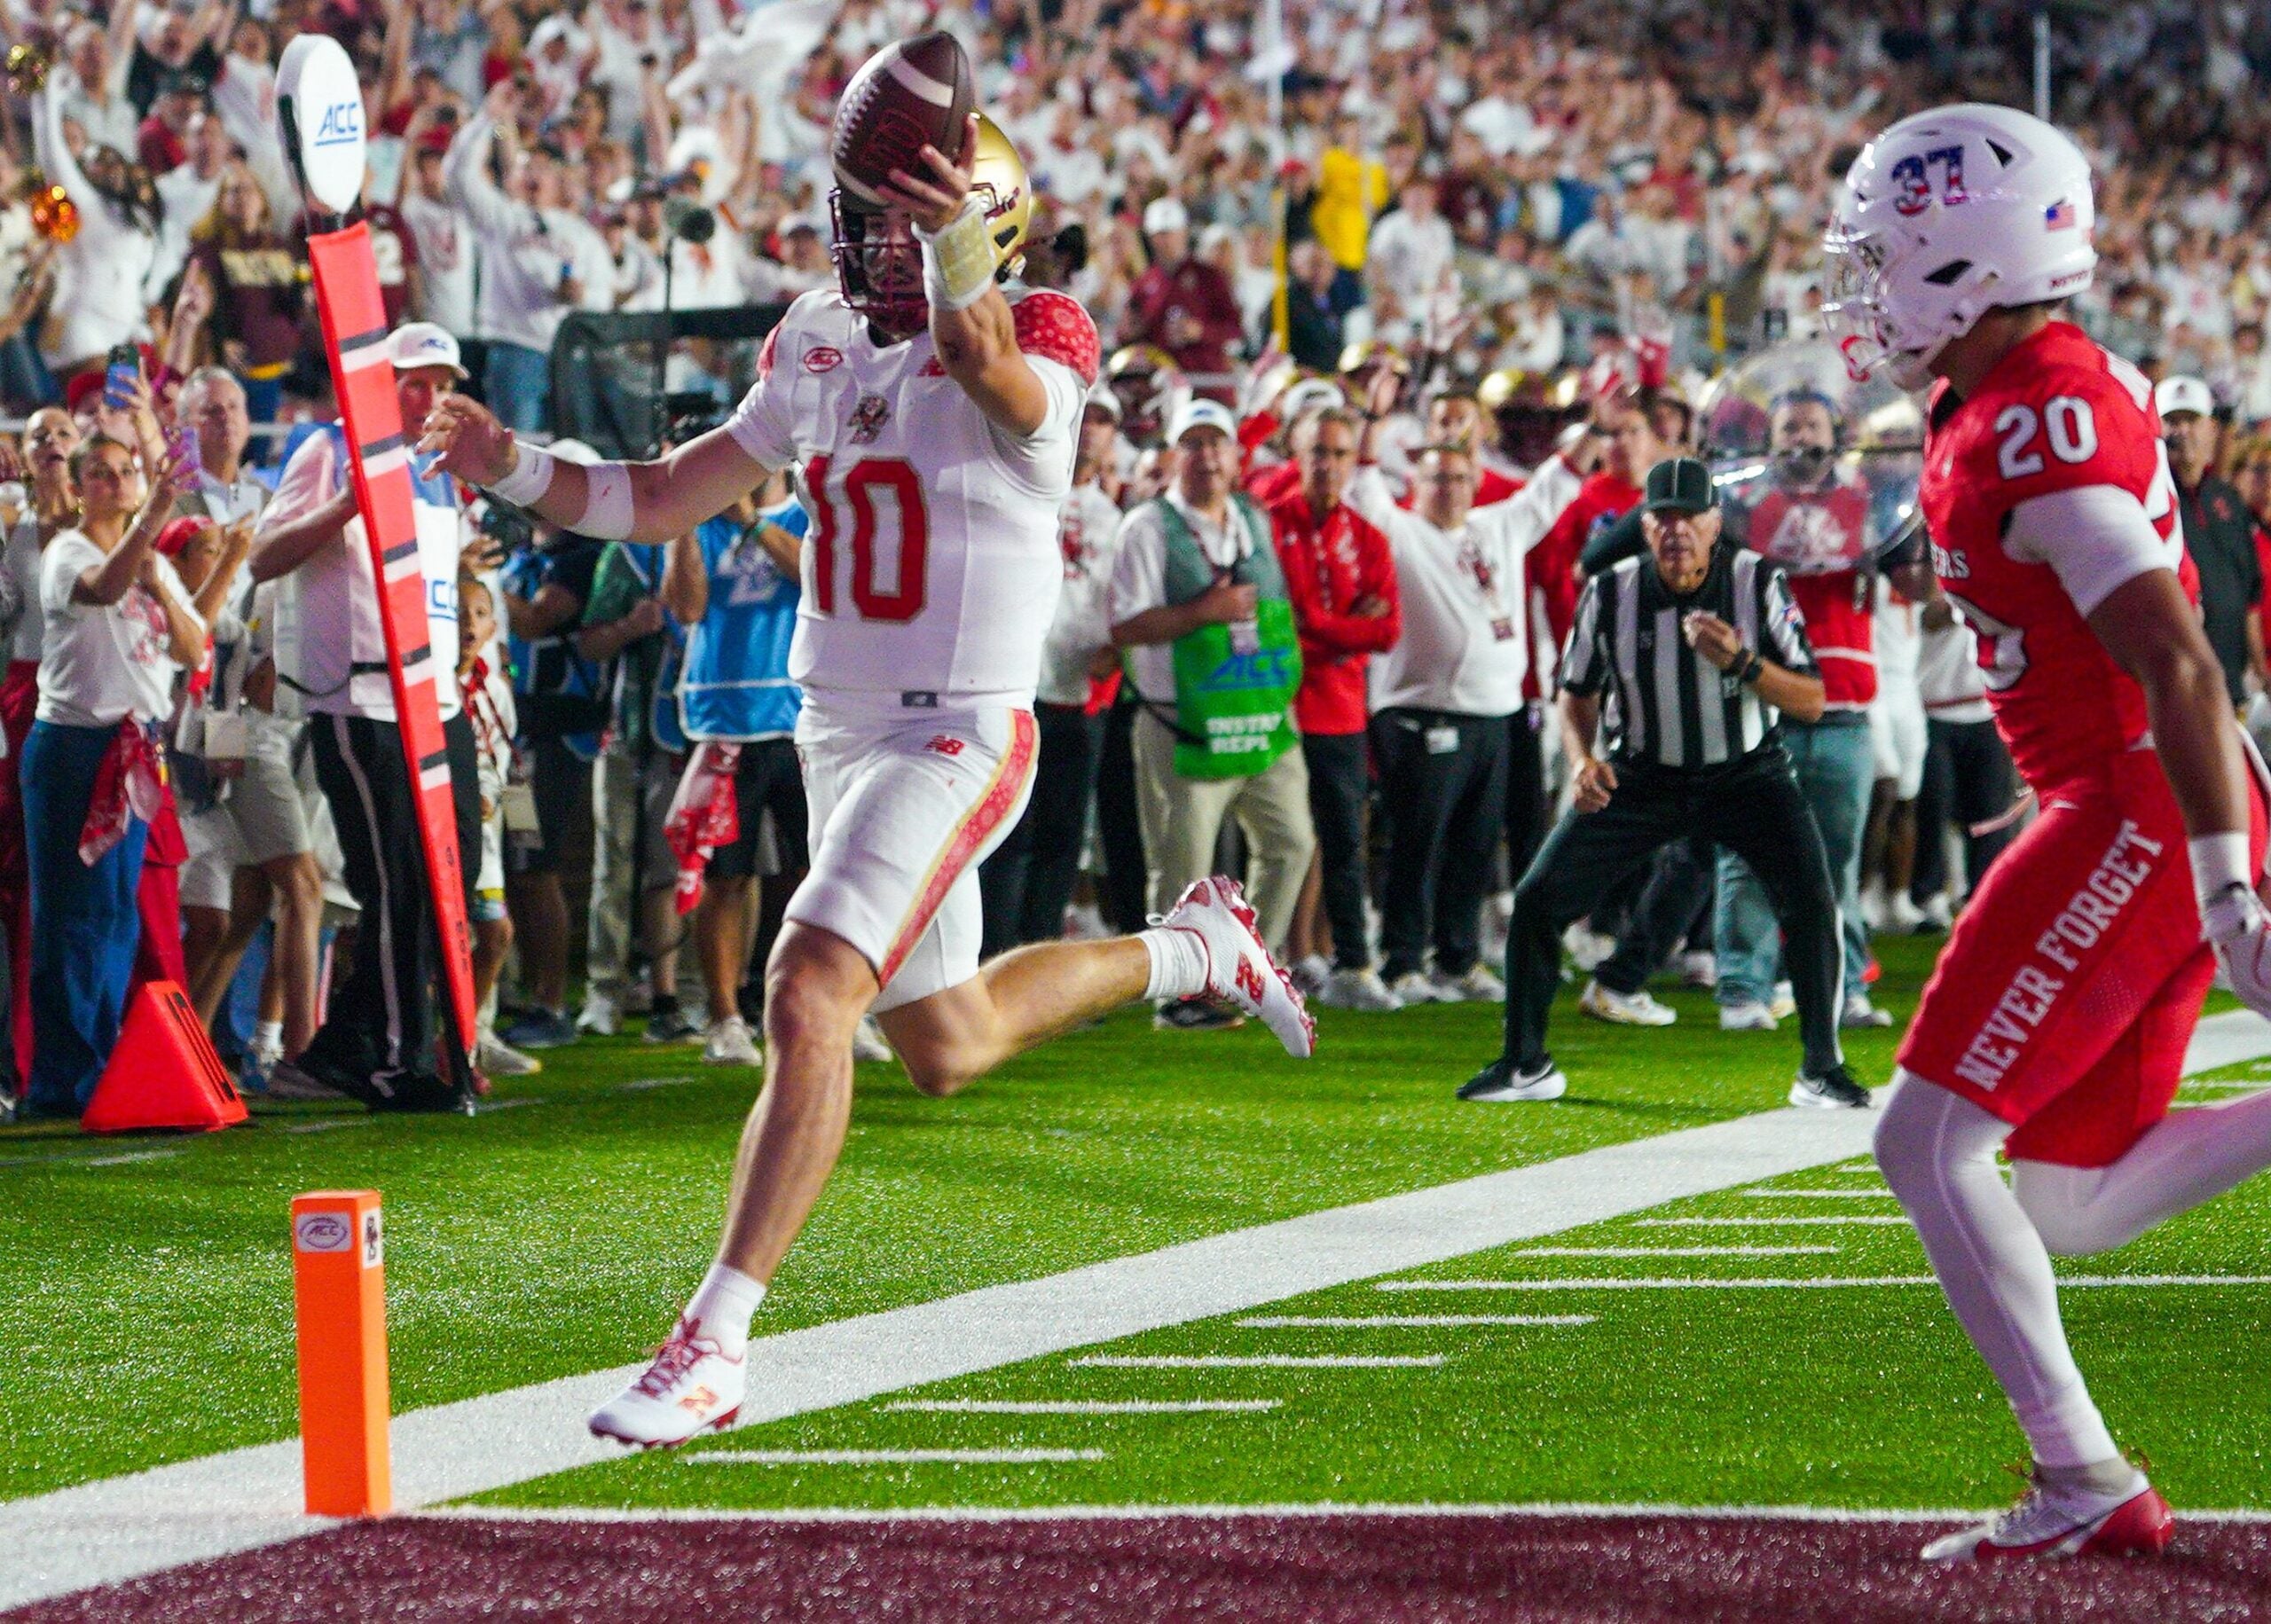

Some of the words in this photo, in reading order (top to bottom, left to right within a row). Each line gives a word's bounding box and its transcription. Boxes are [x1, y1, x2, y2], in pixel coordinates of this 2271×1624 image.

[317, 101, 358, 136] ACC
[1891, 145, 1968, 216] 37
[1994, 395, 2099, 480] 20
[805, 451, 930, 625] 10
[1954, 964, 2065, 1092] NEVER
[2035, 819, 2164, 973] FORGET
